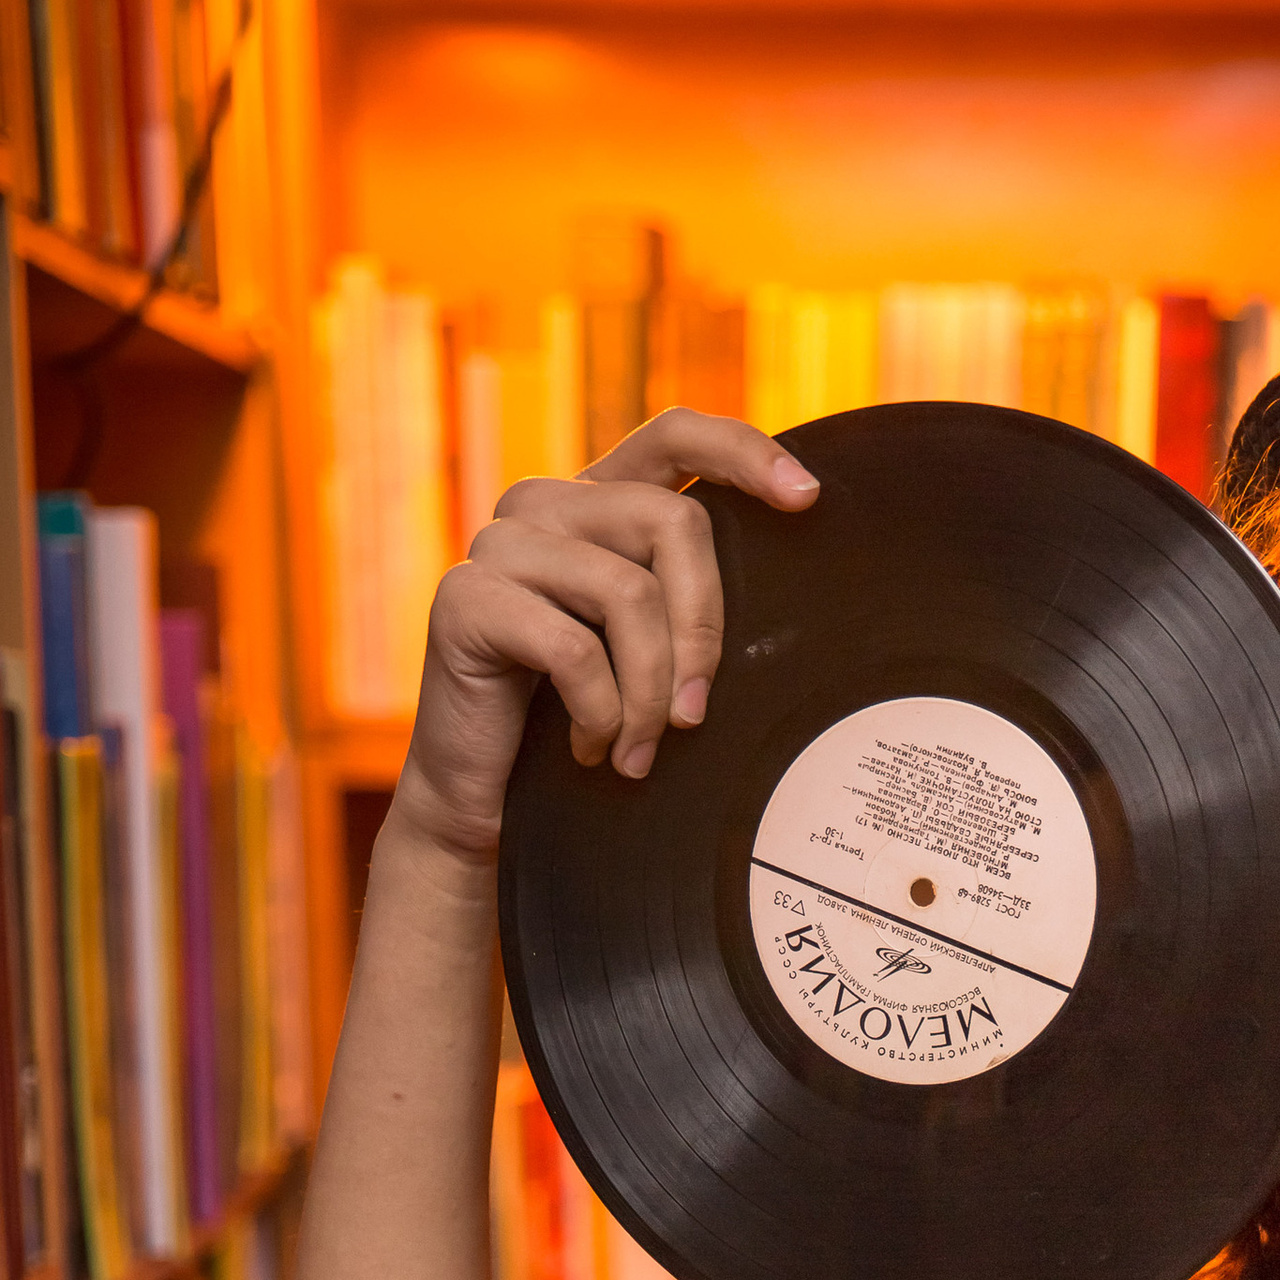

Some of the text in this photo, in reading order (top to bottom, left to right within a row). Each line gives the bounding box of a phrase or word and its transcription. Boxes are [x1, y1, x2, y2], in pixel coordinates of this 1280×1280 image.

[809, 832, 864, 861] Третья гр.-2
[824, 826, 843, 840] 1-30
[773, 890, 792, 908] 33
[957, 887, 1021, 919] ГОСТ 5289-68
[816, 893, 997, 973] АПРЕЛЕВСКИЙ ОРДЕНА ЛЕНИНА ЗАВОД
[784, 923, 998, 1049] МЕЛОДИЯ
[814, 921, 981, 1012] ВСЕСОЮЗНАЯ ФИРМА ГРАМПЛАСТИНОК
[774, 936, 1003, 1062] МИНИСТЕРСТВО КУЛЬТУРЫ СССР
